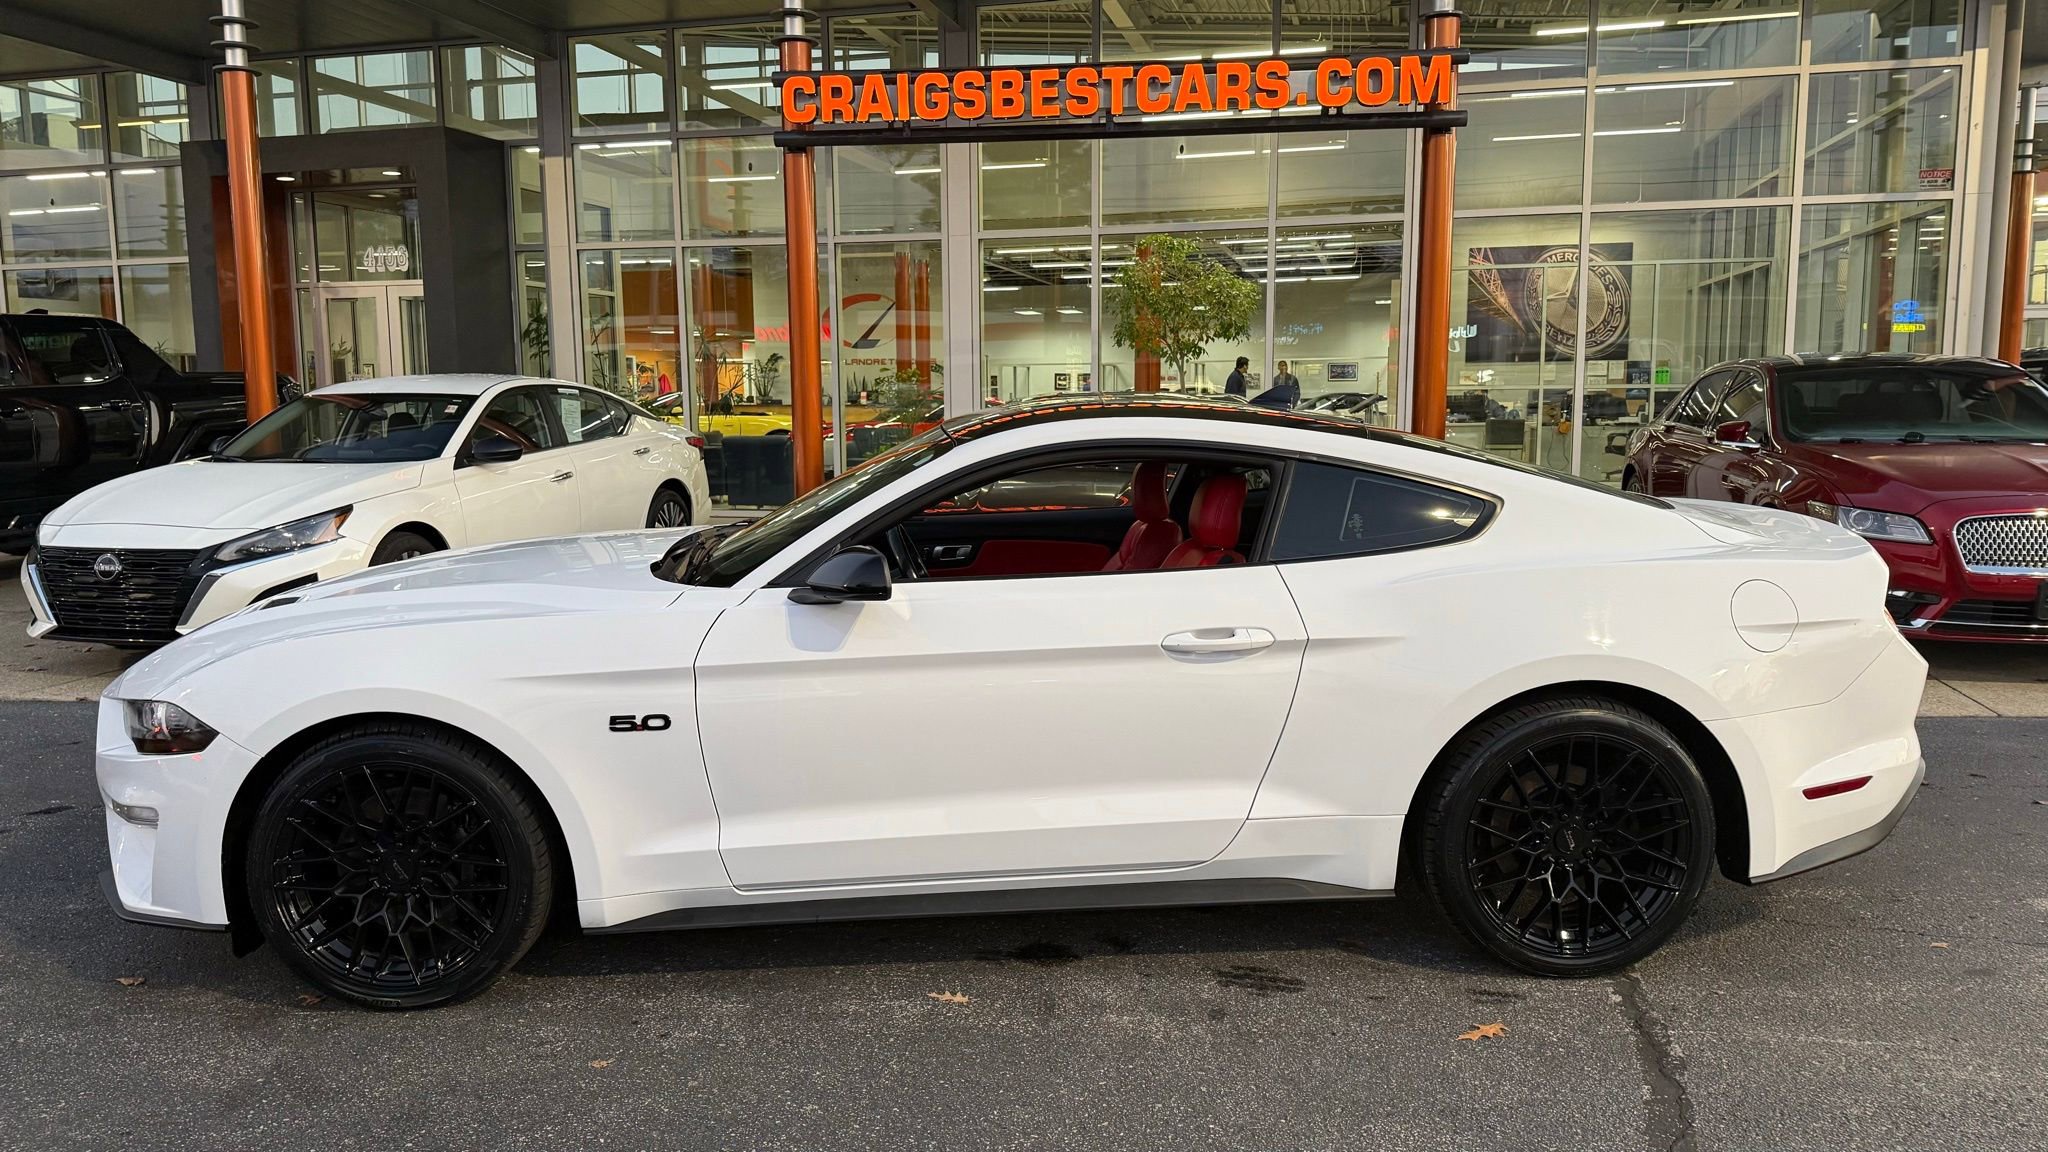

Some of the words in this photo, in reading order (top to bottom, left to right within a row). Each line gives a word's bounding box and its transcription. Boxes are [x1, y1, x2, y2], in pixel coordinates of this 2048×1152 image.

[782, 54, 1451, 124] CRAIGSBESTCARS.COM
[1920, 170, 1952, 178] NOTICE
[363, 245, 409, 272] 4156
[1546, 252, 1613, 285] MERCES
[844, 358, 899, 366] LANDRET
[608, 713, 672, 732] 5.0
